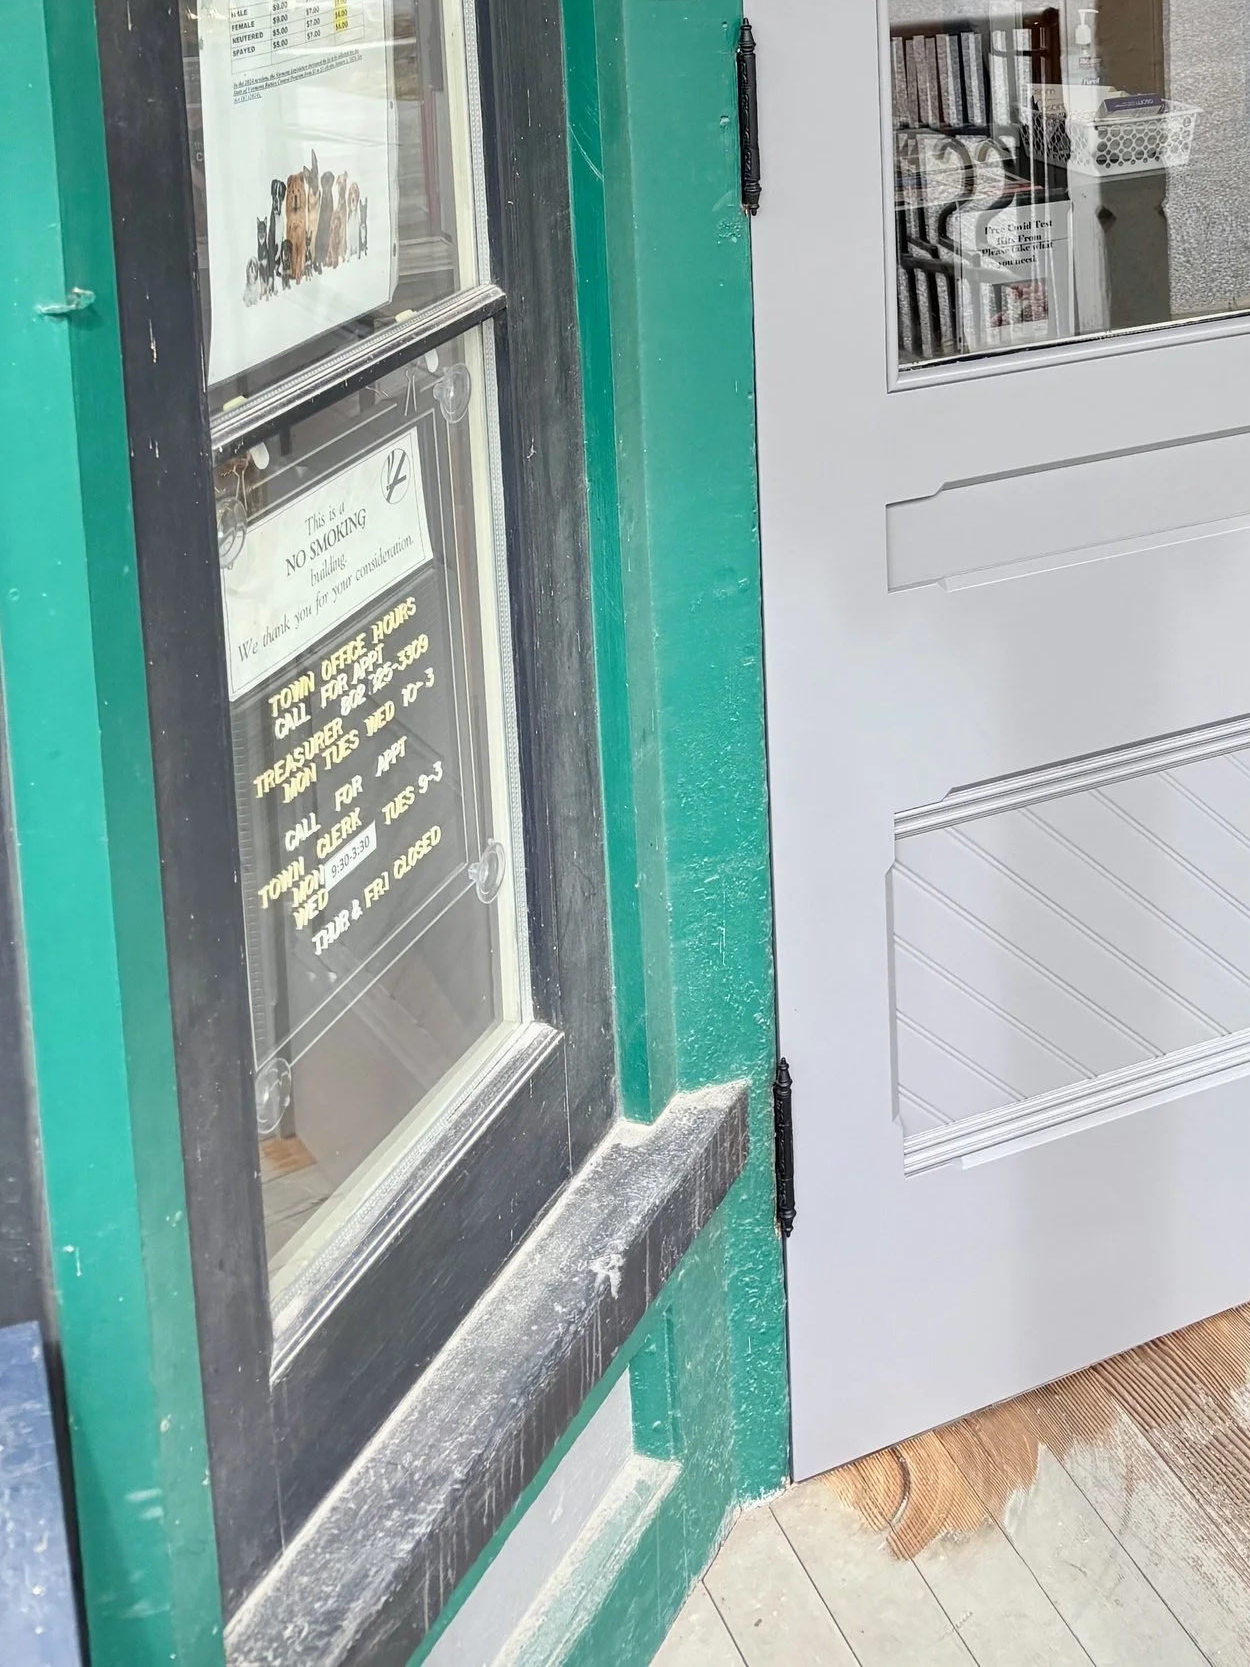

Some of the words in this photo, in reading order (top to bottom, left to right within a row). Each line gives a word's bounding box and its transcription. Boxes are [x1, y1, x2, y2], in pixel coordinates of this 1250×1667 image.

[232, 21, 254, 31] FEMALE
[232, 32, 263, 44] NEUTERED
[233, 46, 255, 57] SPAYED
[982, 248, 1009, 256] Please
[985, 226, 1005, 234] Free
[285, 550, 306, 576] NO
[310, 509, 366, 560] SMOKING
[305, 513, 325, 536] This
[329, 507, 336, 520] is
[339, 502, 344, 514] a
[238, 638, 258, 662] We
[263, 615, 290, 647] thank
[295, 606, 312, 630] you
[315, 591, 329, 616] for
[332, 575, 352, 603] your
[356, 535, 414, 581] consideration.
[310, 553, 347, 587] building.
[269, 671, 315, 717] TOWN
[321, 633, 366, 680] OFFICE
[371, 597, 416, 643] HOURS
[275, 703, 311, 739] CALL
[320, 673, 348, 708] FOR
[352, 644, 384, 684] APPT
[341, 684, 366, 716] 802
[254, 717, 343, 798] TREASURER
[283, 763, 317, 803] MON
[322, 730, 359, 770] TUES
[364, 701, 395, 736] WED
[285, 813, 321, 851] CALL
[335, 775, 363, 811] FOR
[376, 736, 407, 777] APPT
[259, 856, 304, 909] TOWN
[317, 807, 362, 859] CLERK
[382, 786, 415, 825] TUES
[418, 761, 443, 793] 9-3
[292, 865, 325, 907] MON
[331, 836, 370, 878] 9:30-3:30
[352, 899, 363, 920] &
[365, 872, 389, 908] FRI
[394, 825, 441, 879] CLOSED
[293, 888, 329, 930] WED
